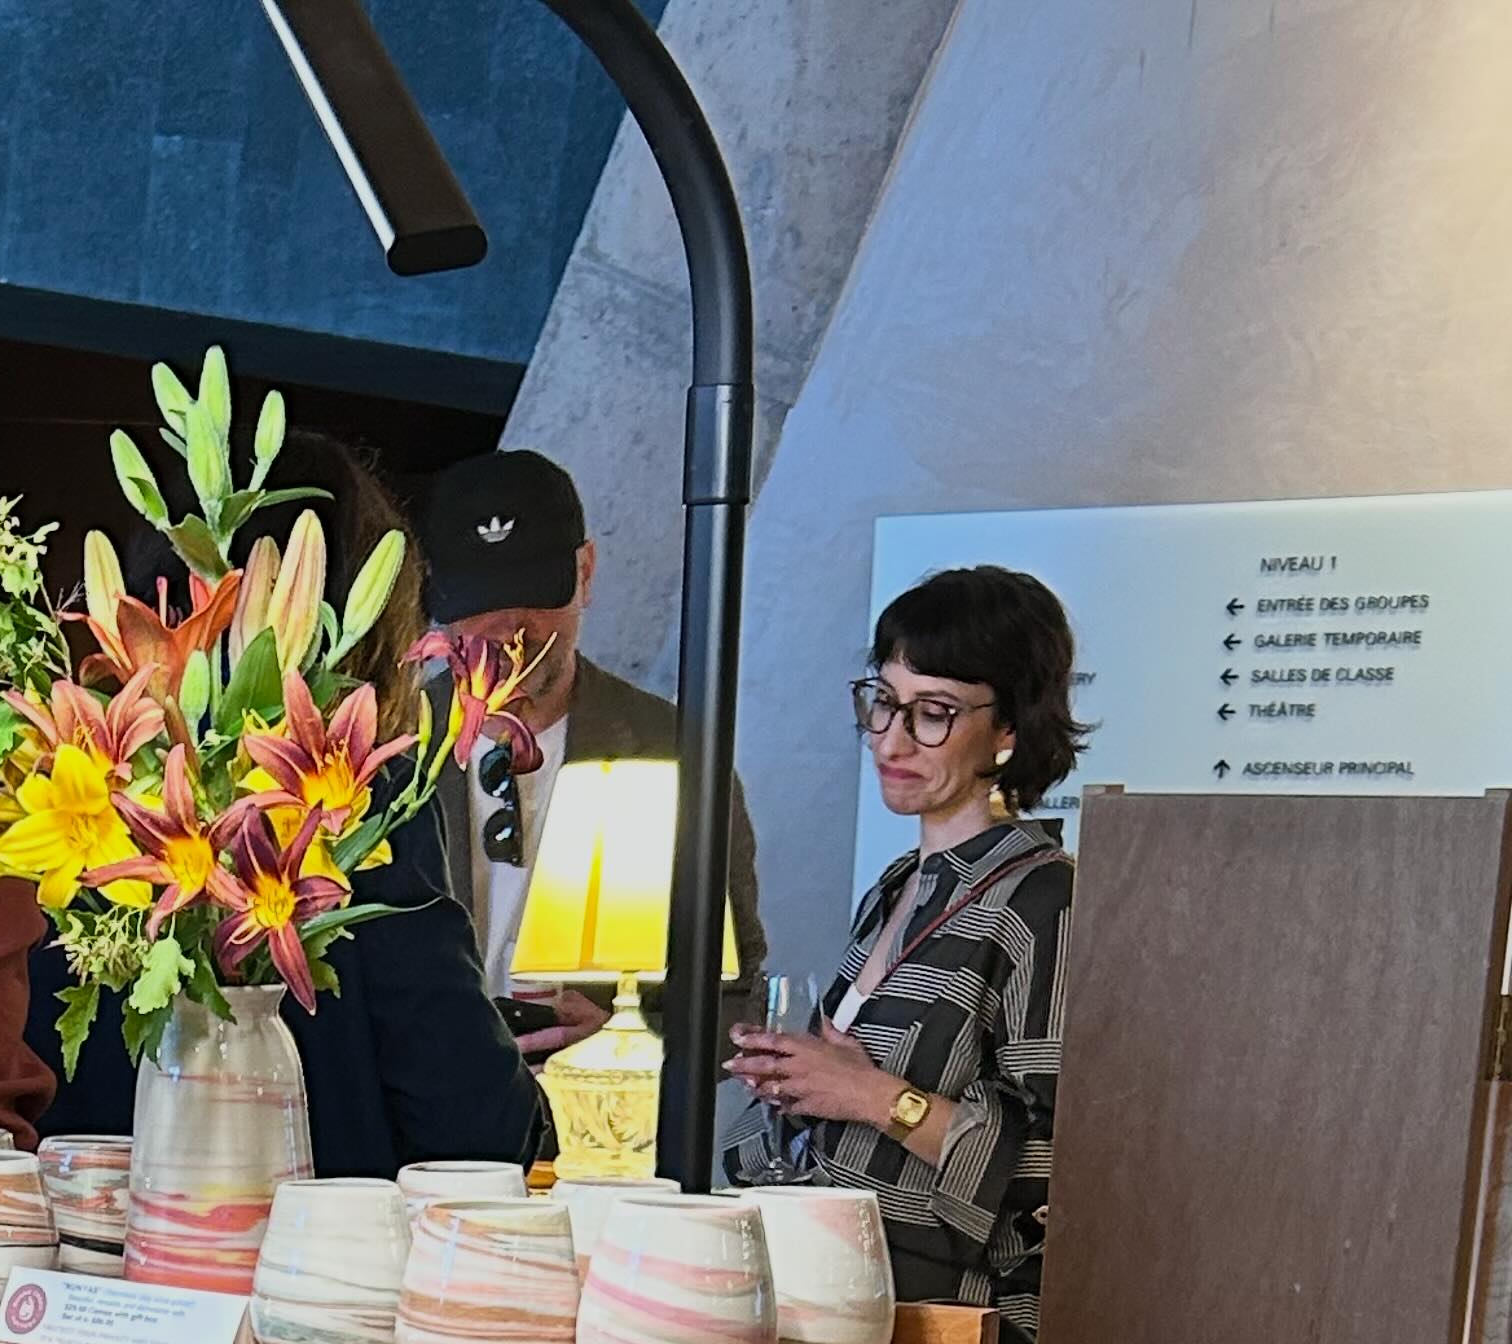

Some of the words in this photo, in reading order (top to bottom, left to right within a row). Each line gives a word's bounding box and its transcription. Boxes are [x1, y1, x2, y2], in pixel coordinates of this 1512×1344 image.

[1259, 556, 1324, 573] NIVEAU
[1330, 555, 1338, 570] 1
[1256, 597, 1315, 614] ENTRÉE
[1319, 596, 1350, 611] DES
[1354, 594, 1430, 611] GROUPES
[1254, 633, 1318, 648] GALERIE
[1324, 630, 1423, 646] TEMPORAIRE
[1250, 669, 1307, 683] SALLES
[1311, 668, 1332, 682] DE
[1335, 667, 1396, 681] CLASSE
[1248, 701, 1317, 718] THÉÂTRE
[1241, 761, 1335, 776] ASCENSEUR
[1338, 761, 1415, 775] PRINCIPAL
